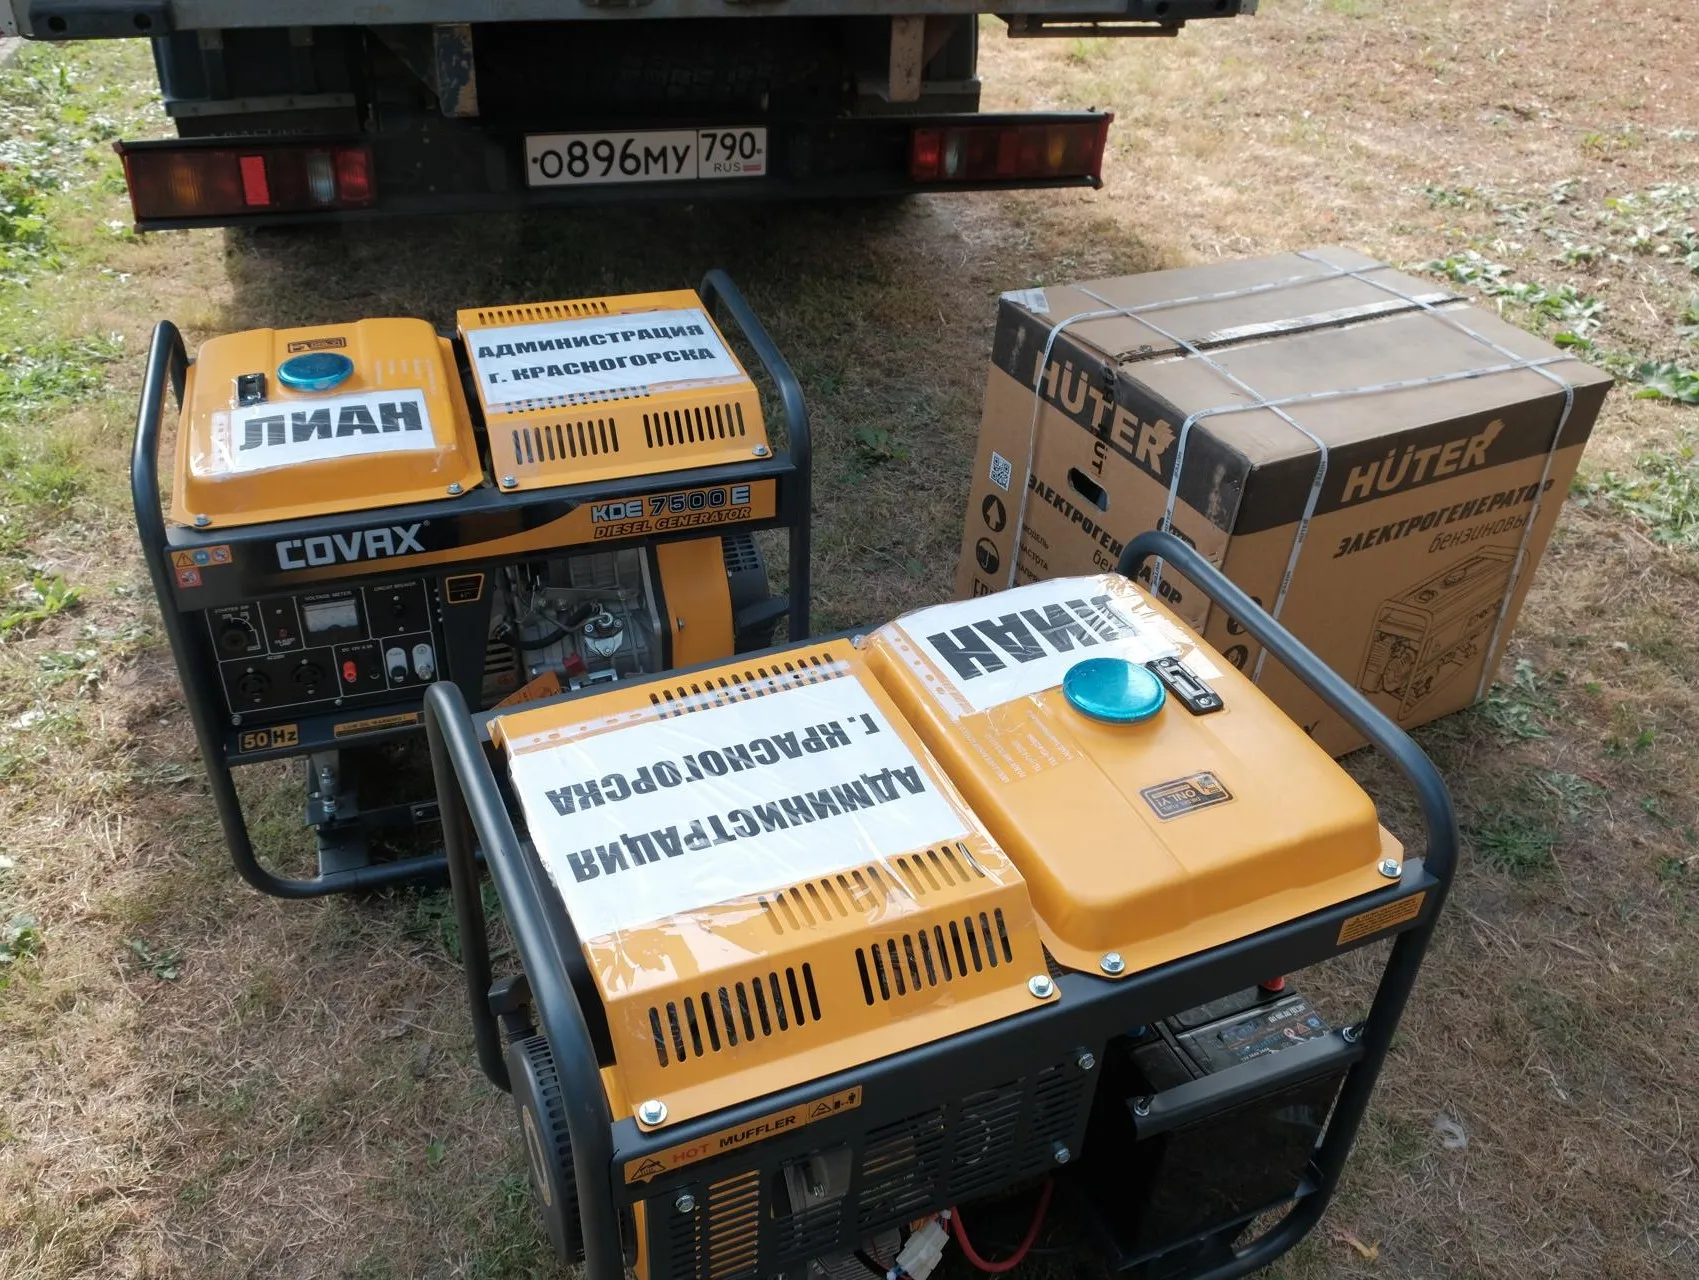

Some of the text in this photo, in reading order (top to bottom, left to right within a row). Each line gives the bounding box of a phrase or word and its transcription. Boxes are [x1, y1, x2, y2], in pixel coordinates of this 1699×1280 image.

[701, 131, 757, 162] 790
[713, 162, 742, 173] RUS
[478, 324, 705, 359] АДМИНИСТРАЦИЯ
[512, 348, 716, 381] КРАСНОГОРСКА
[239, 401, 423, 451] ЛИАН
[1032, 350, 1176, 475] HÜTER
[1341, 419, 1506, 503] HÜTER
[592, 485, 750, 523] KDE 7500 E
[595, 507, 751, 539] DIESEL GENERATOR
[1027, 473, 1184, 605] ЭЛЕКТРОГЕНАОР
[926, 594, 1138, 682] ЛИАН
[544, 720, 852, 817] КРАСНОГОРСКА
[565, 765, 927, 883] АДМИНИСТРАЦИЯ
[672, 1115, 797, 1164] HOT MUFFLER
